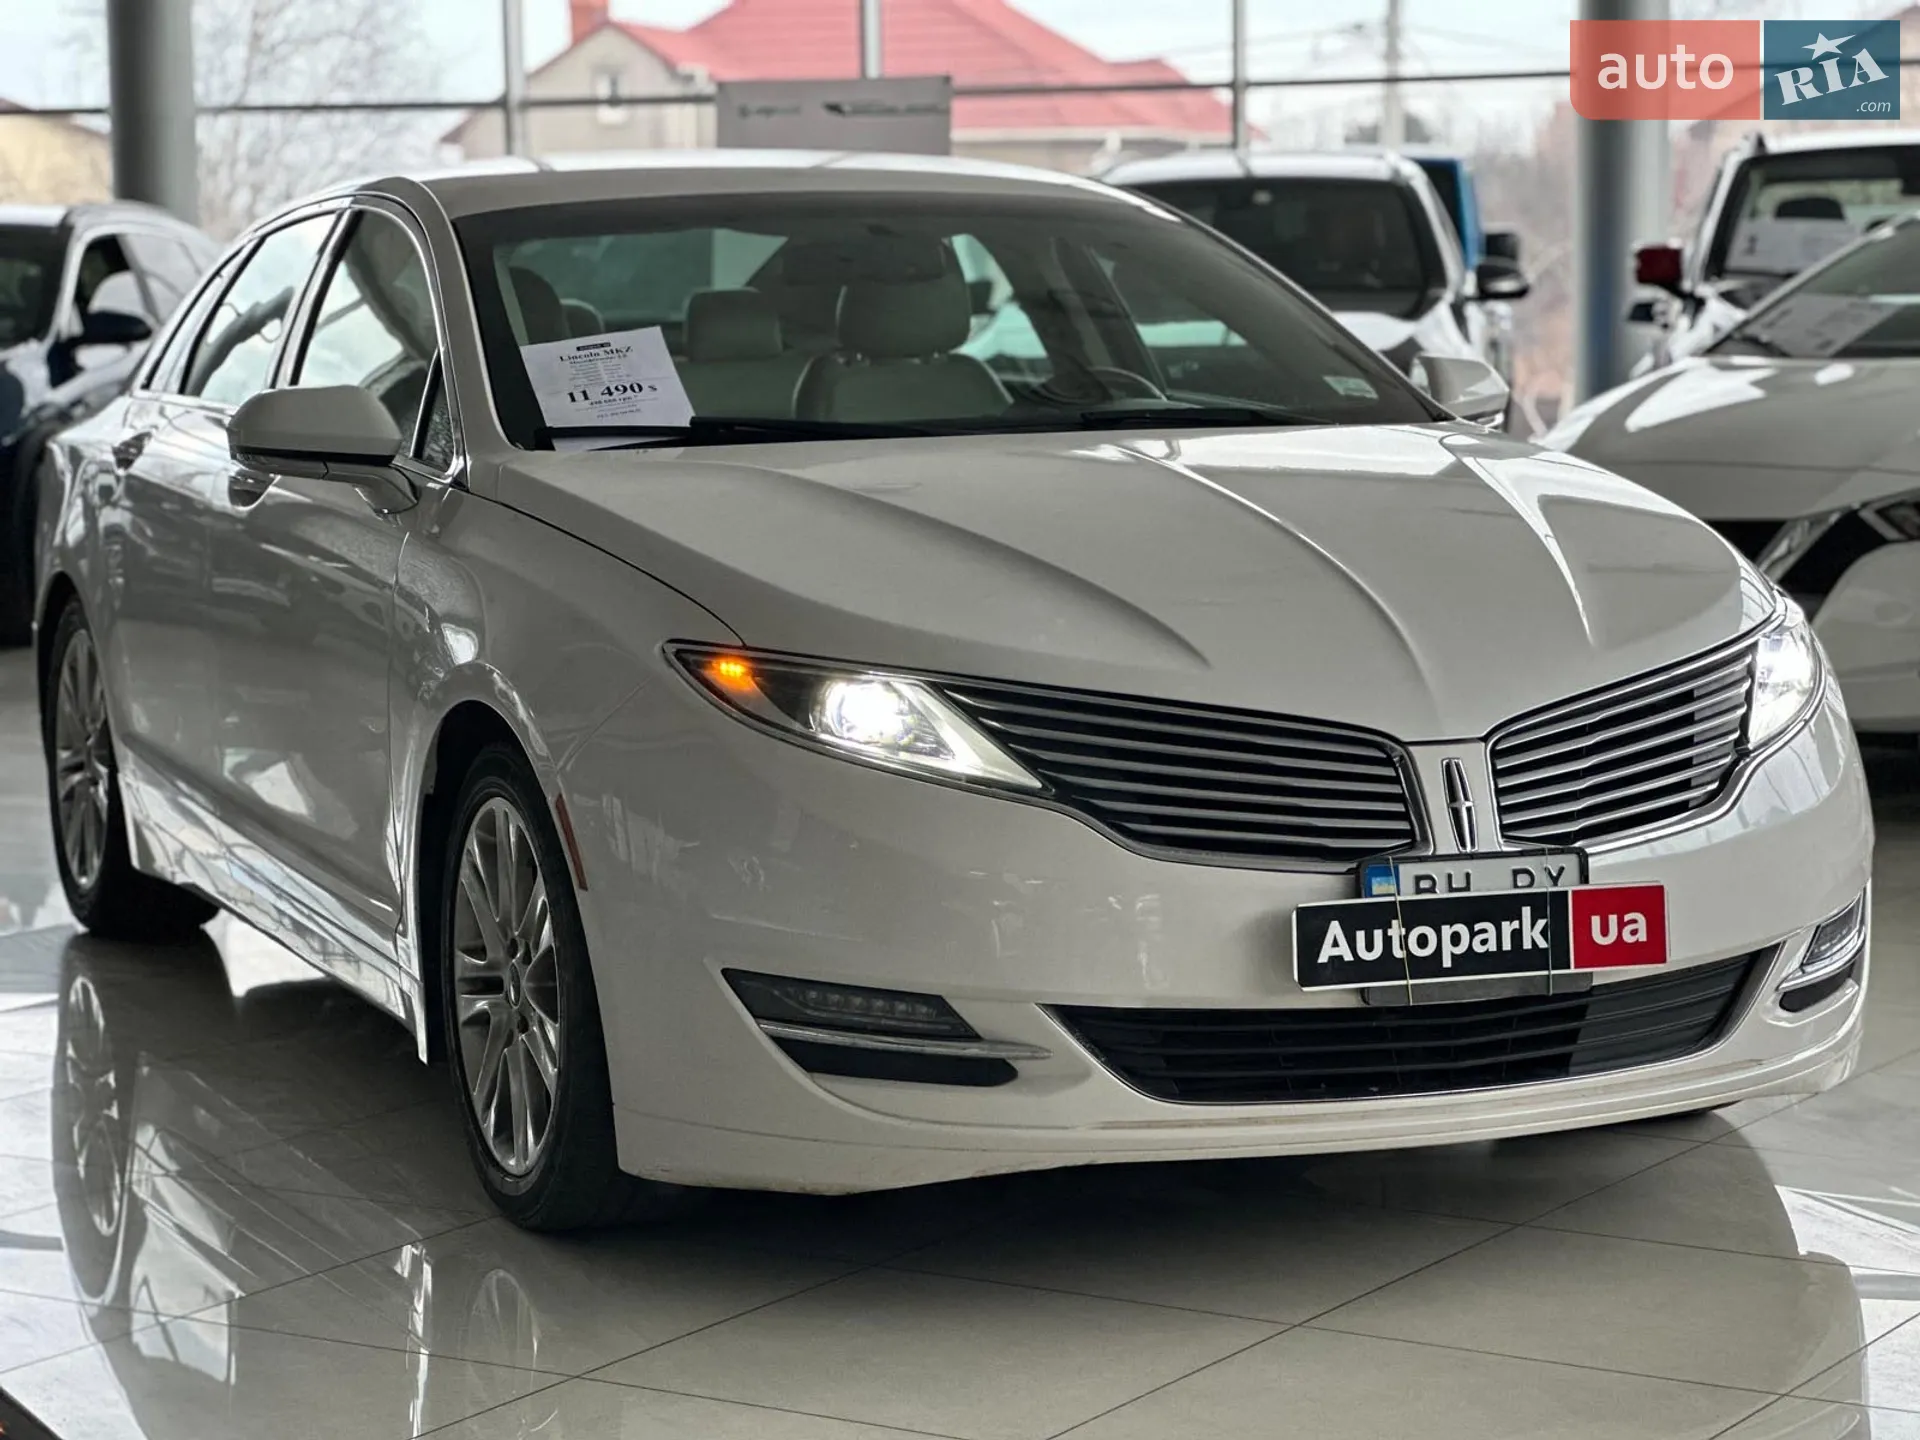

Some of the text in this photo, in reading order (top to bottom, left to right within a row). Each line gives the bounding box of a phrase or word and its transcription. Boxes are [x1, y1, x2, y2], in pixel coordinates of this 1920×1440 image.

[559, 351, 600, 362] Lincoln
[603, 345, 634, 356] MKZ
[567, 389, 590, 403] 11
[600, 382, 644, 397] 490
[1316, 906, 1648, 969] Autopark ua
